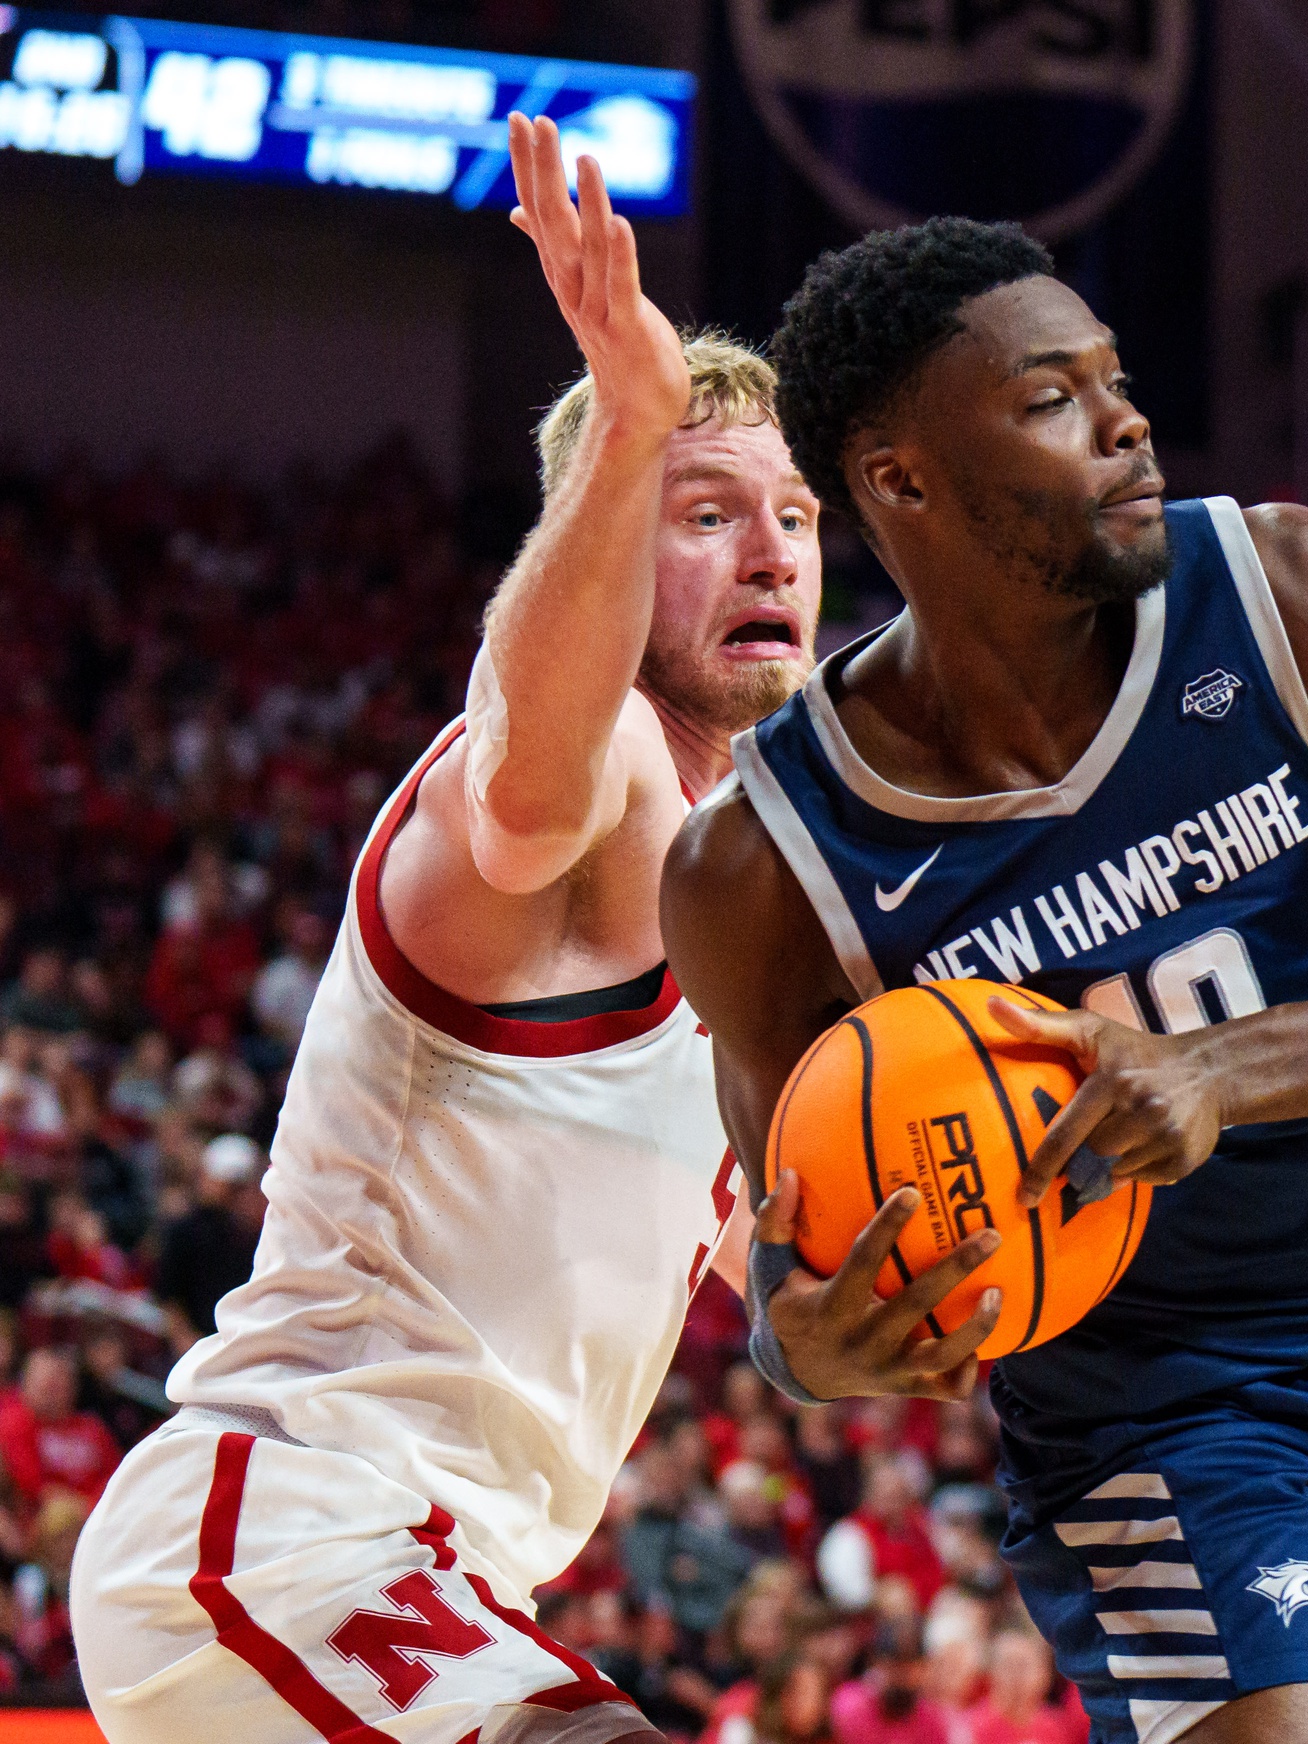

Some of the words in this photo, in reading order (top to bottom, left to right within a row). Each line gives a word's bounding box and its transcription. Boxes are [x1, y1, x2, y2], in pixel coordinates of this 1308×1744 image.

[1184, 677, 1237, 710] AMERICA
[1199, 690, 1229, 709] EAST
[907, 1121, 929, 1177] OFFICIAL
[921, 1182, 938, 1217] GAME
[931, 1222, 949, 1252] BALL
[325, 1568, 498, 1712] N
